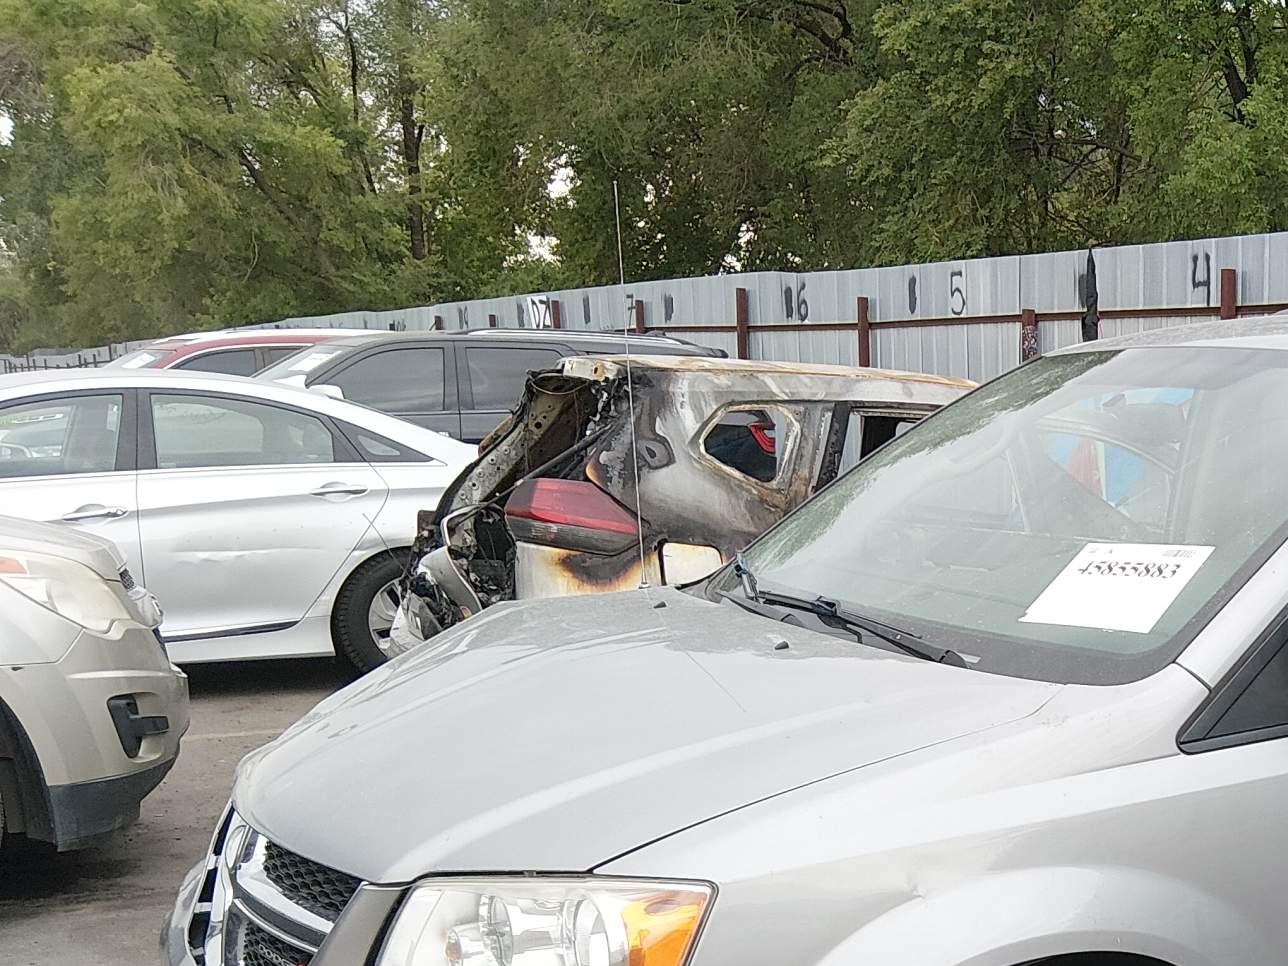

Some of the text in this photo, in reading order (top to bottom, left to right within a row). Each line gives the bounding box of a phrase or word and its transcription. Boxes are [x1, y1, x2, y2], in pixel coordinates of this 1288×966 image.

[950, 270, 966, 316] 5
[1192, 252, 1211, 306] 4
[1078, 560, 1182, 579] 45855883
